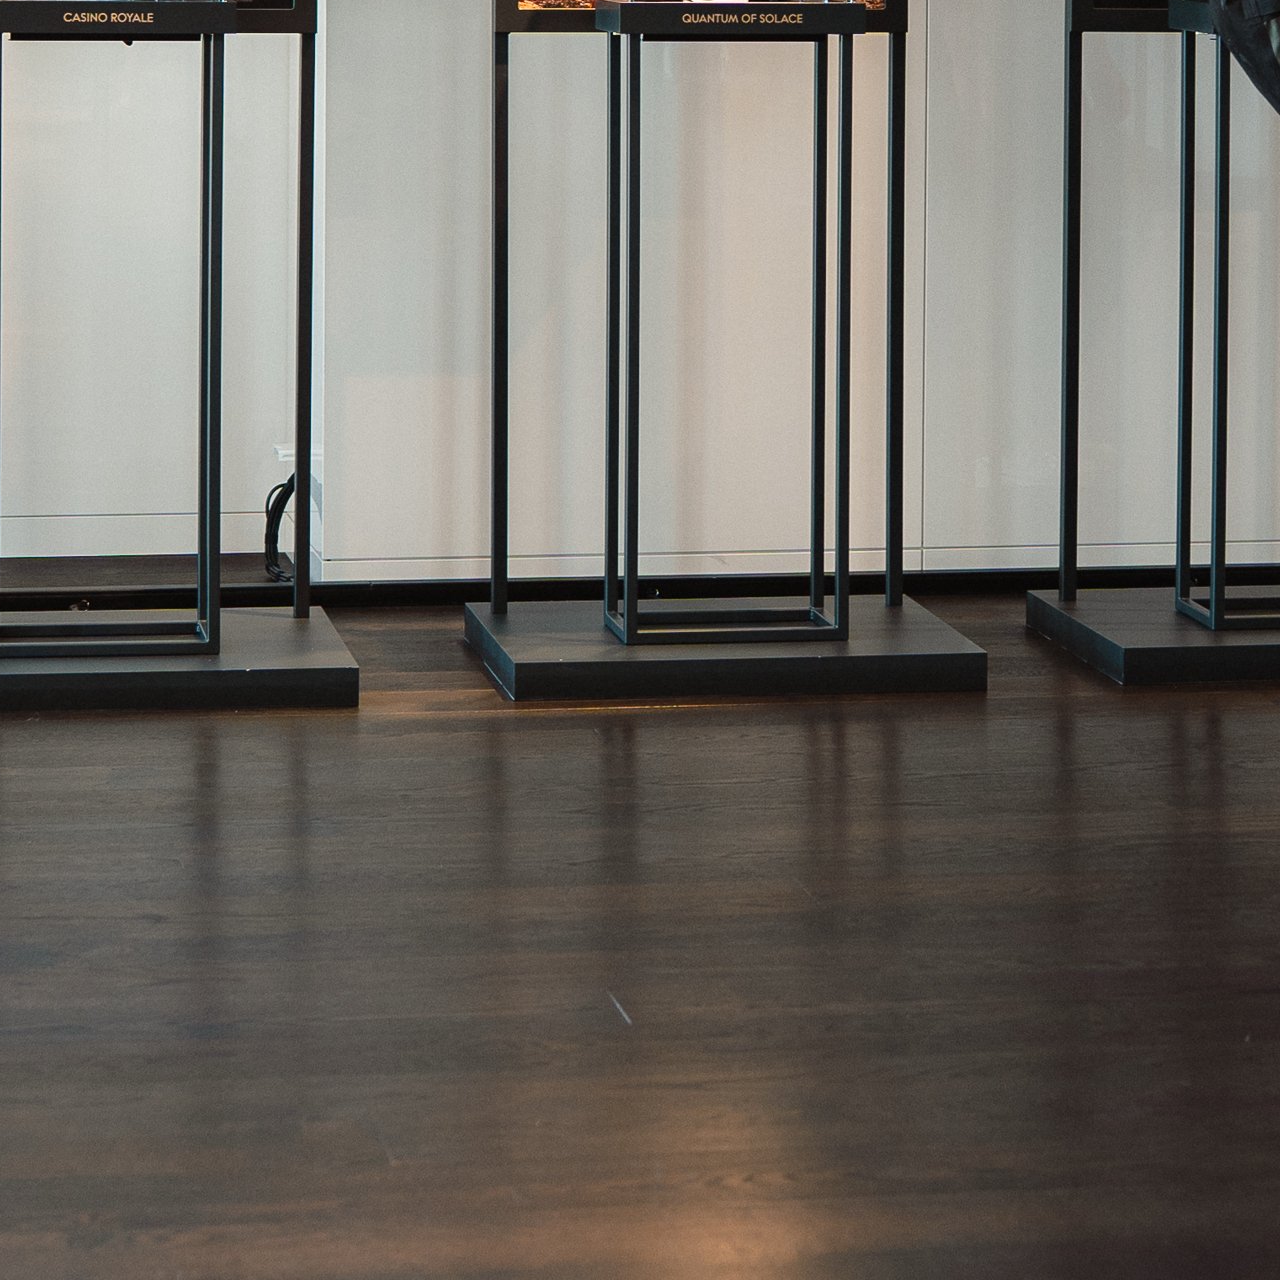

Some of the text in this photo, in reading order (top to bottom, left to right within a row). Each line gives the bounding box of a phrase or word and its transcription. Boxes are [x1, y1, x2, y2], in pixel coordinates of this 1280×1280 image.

[63, 12, 154, 23] CASINO ROYALE
[681, 13, 803, 24] QUANTUM OF SOLACE
